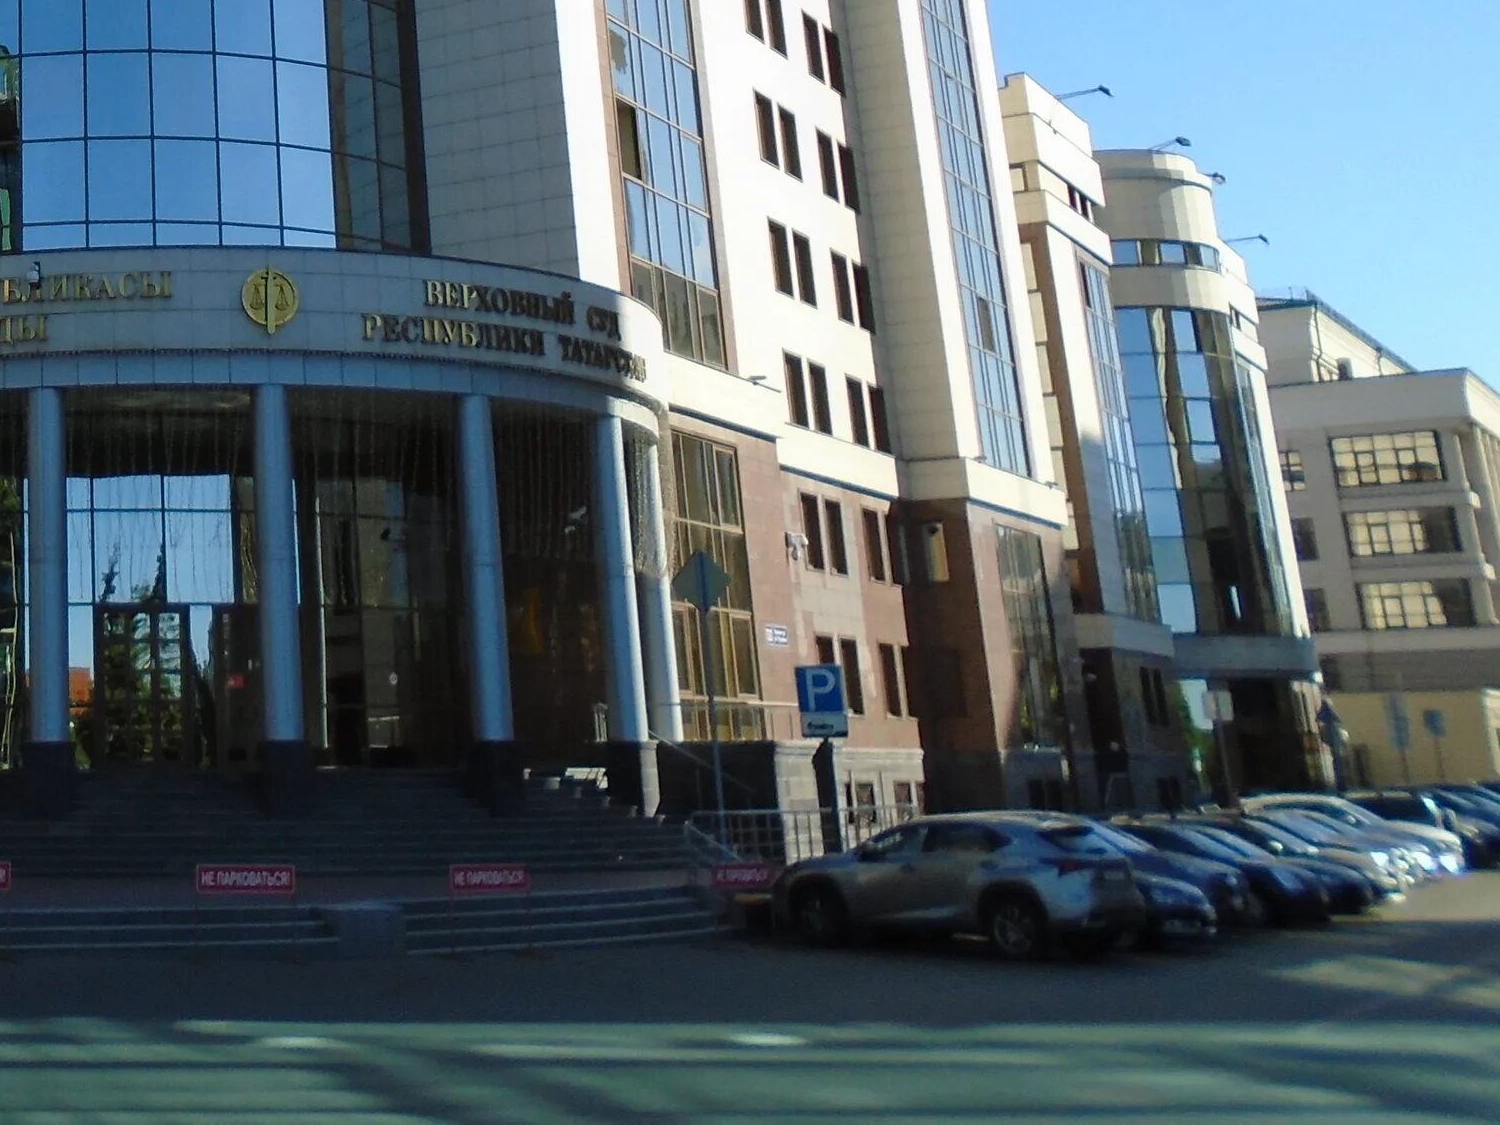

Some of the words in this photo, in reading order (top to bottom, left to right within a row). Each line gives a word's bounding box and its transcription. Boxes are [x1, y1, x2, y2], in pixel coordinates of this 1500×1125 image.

[422, 279, 576, 326] ВЕРХОВНЫЙ
[361, 312, 546, 356] РЕСПУБЛИКИ
[201, 871, 215, 886] НЕ
